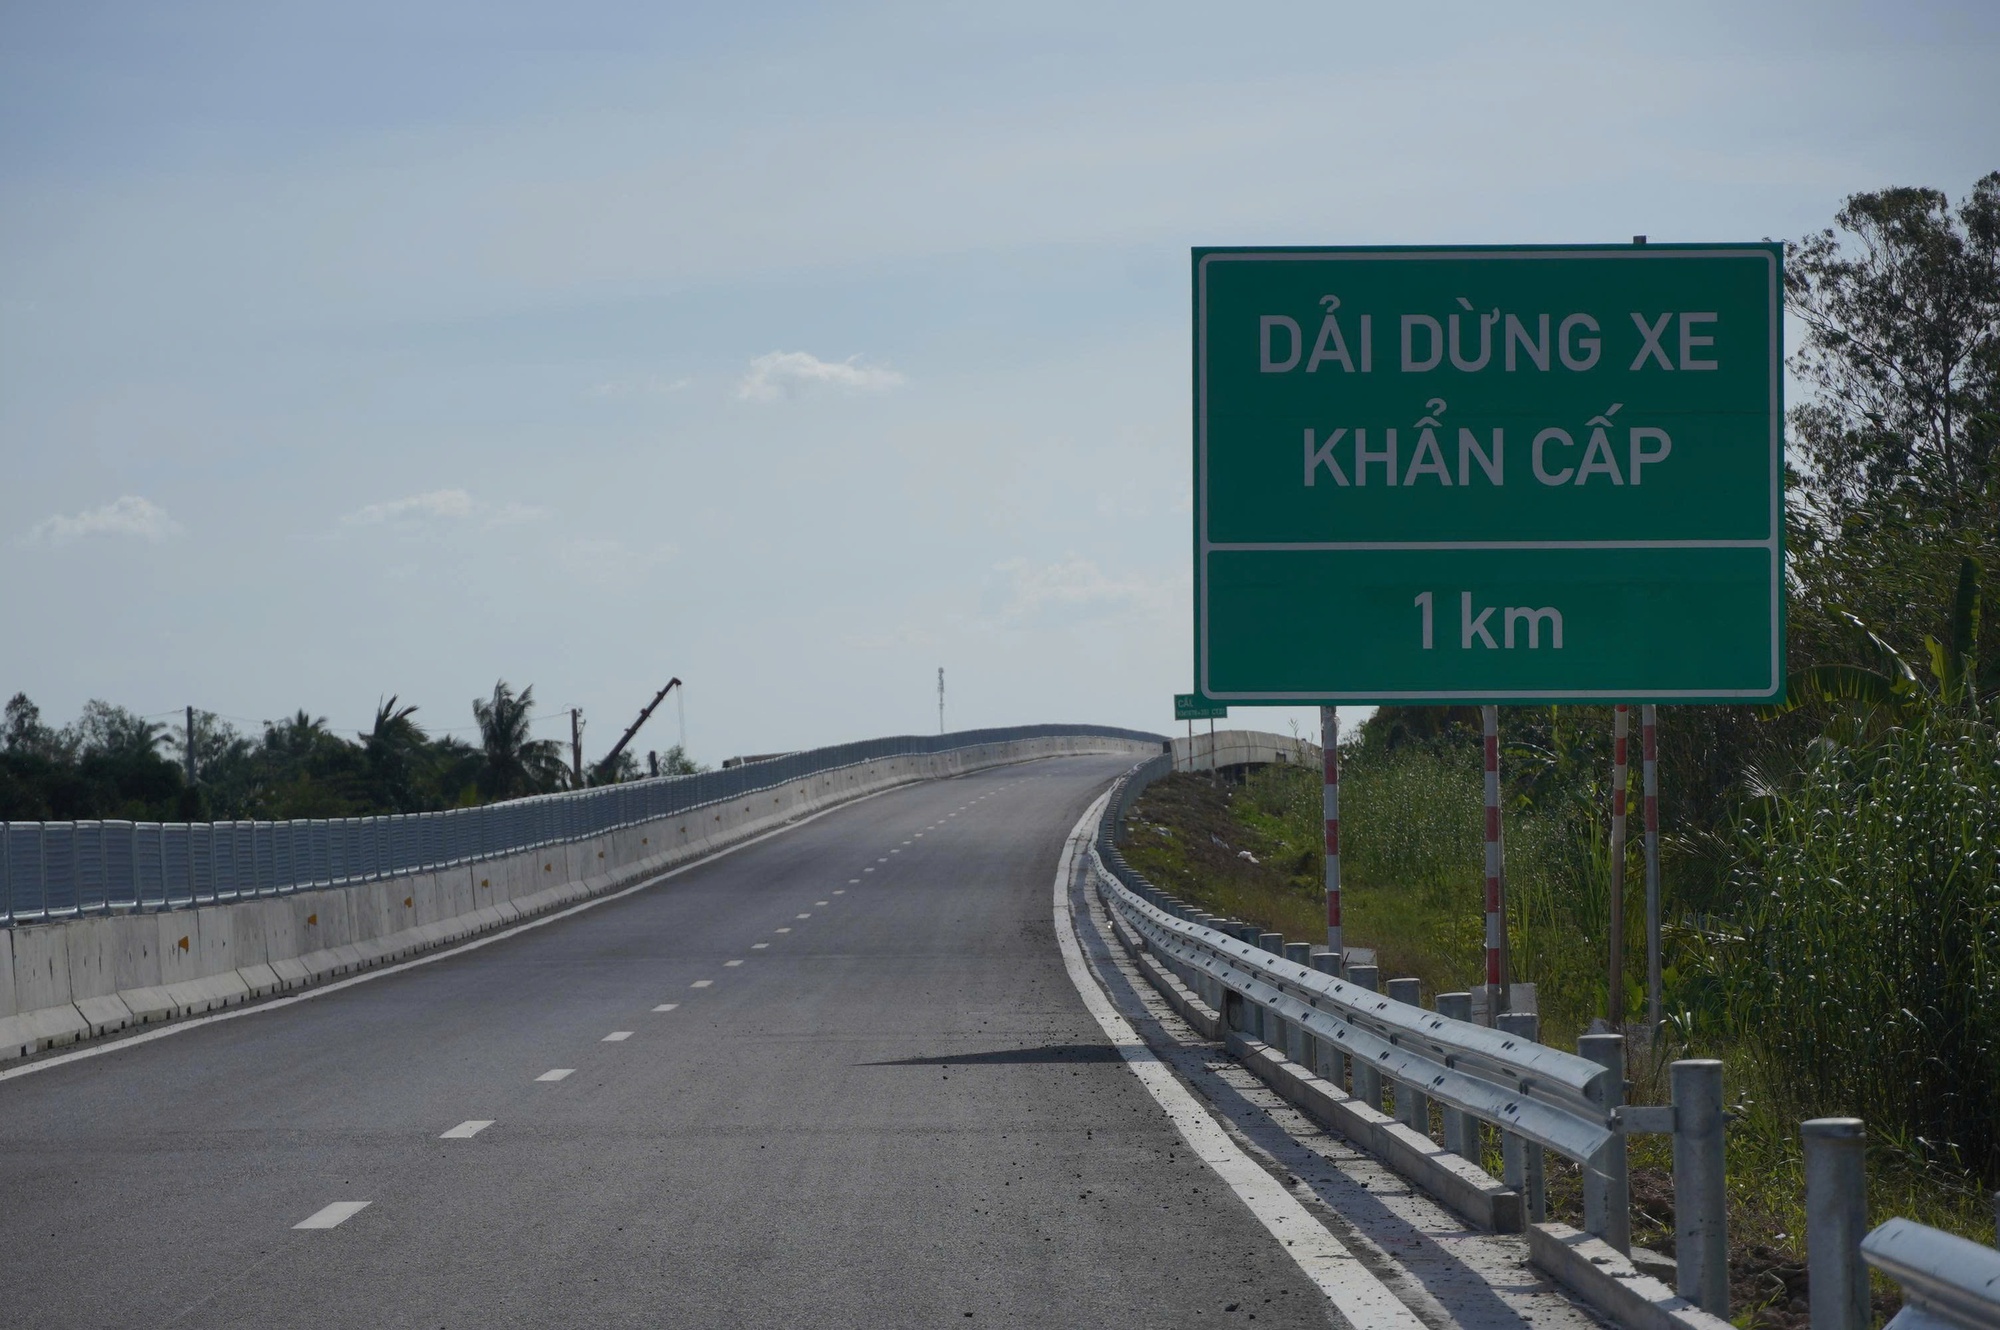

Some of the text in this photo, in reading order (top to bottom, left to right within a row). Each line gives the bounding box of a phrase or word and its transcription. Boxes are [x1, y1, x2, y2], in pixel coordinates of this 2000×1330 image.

[1260, 295, 1718, 373] DẢI DỪNG XE
[1304, 398, 1672, 487] KHẨN CẤP
[1414, 591, 1563, 650] 1 km
